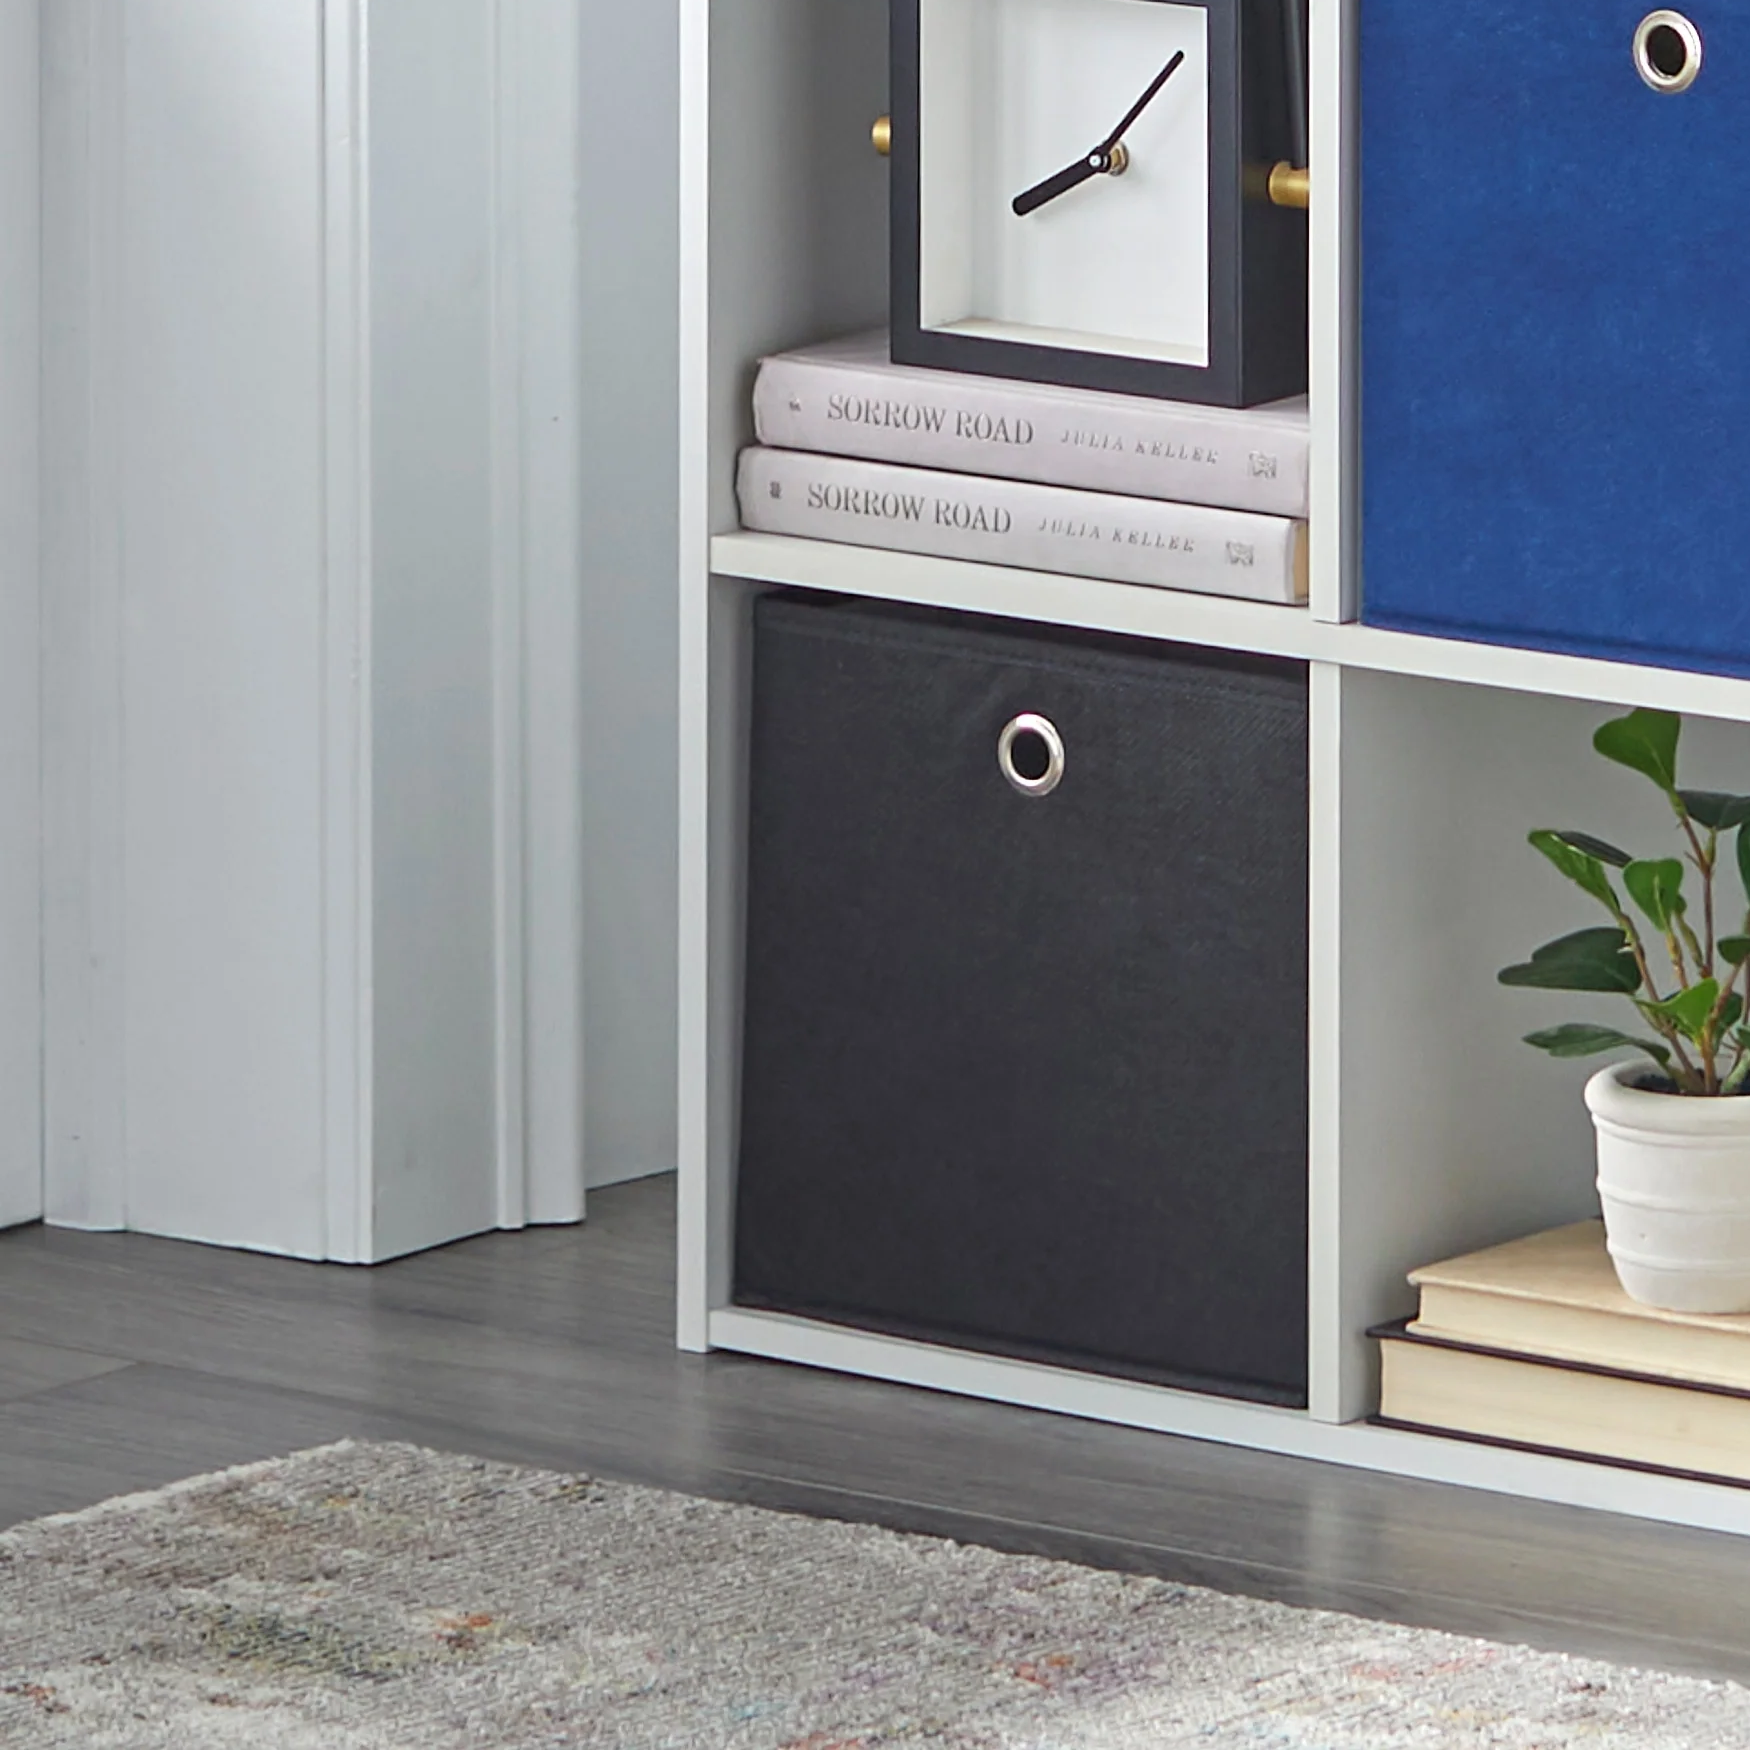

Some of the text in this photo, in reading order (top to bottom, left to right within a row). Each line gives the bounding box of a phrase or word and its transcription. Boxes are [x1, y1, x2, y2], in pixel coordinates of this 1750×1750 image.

[827, 393, 1034, 446] SORROW ROAD
[1060, 429, 1218, 465] JULIA KELLER
[807, 482, 1012, 534] SORROW ROAD
[1038, 517, 1195, 553] JULIA KELLER
